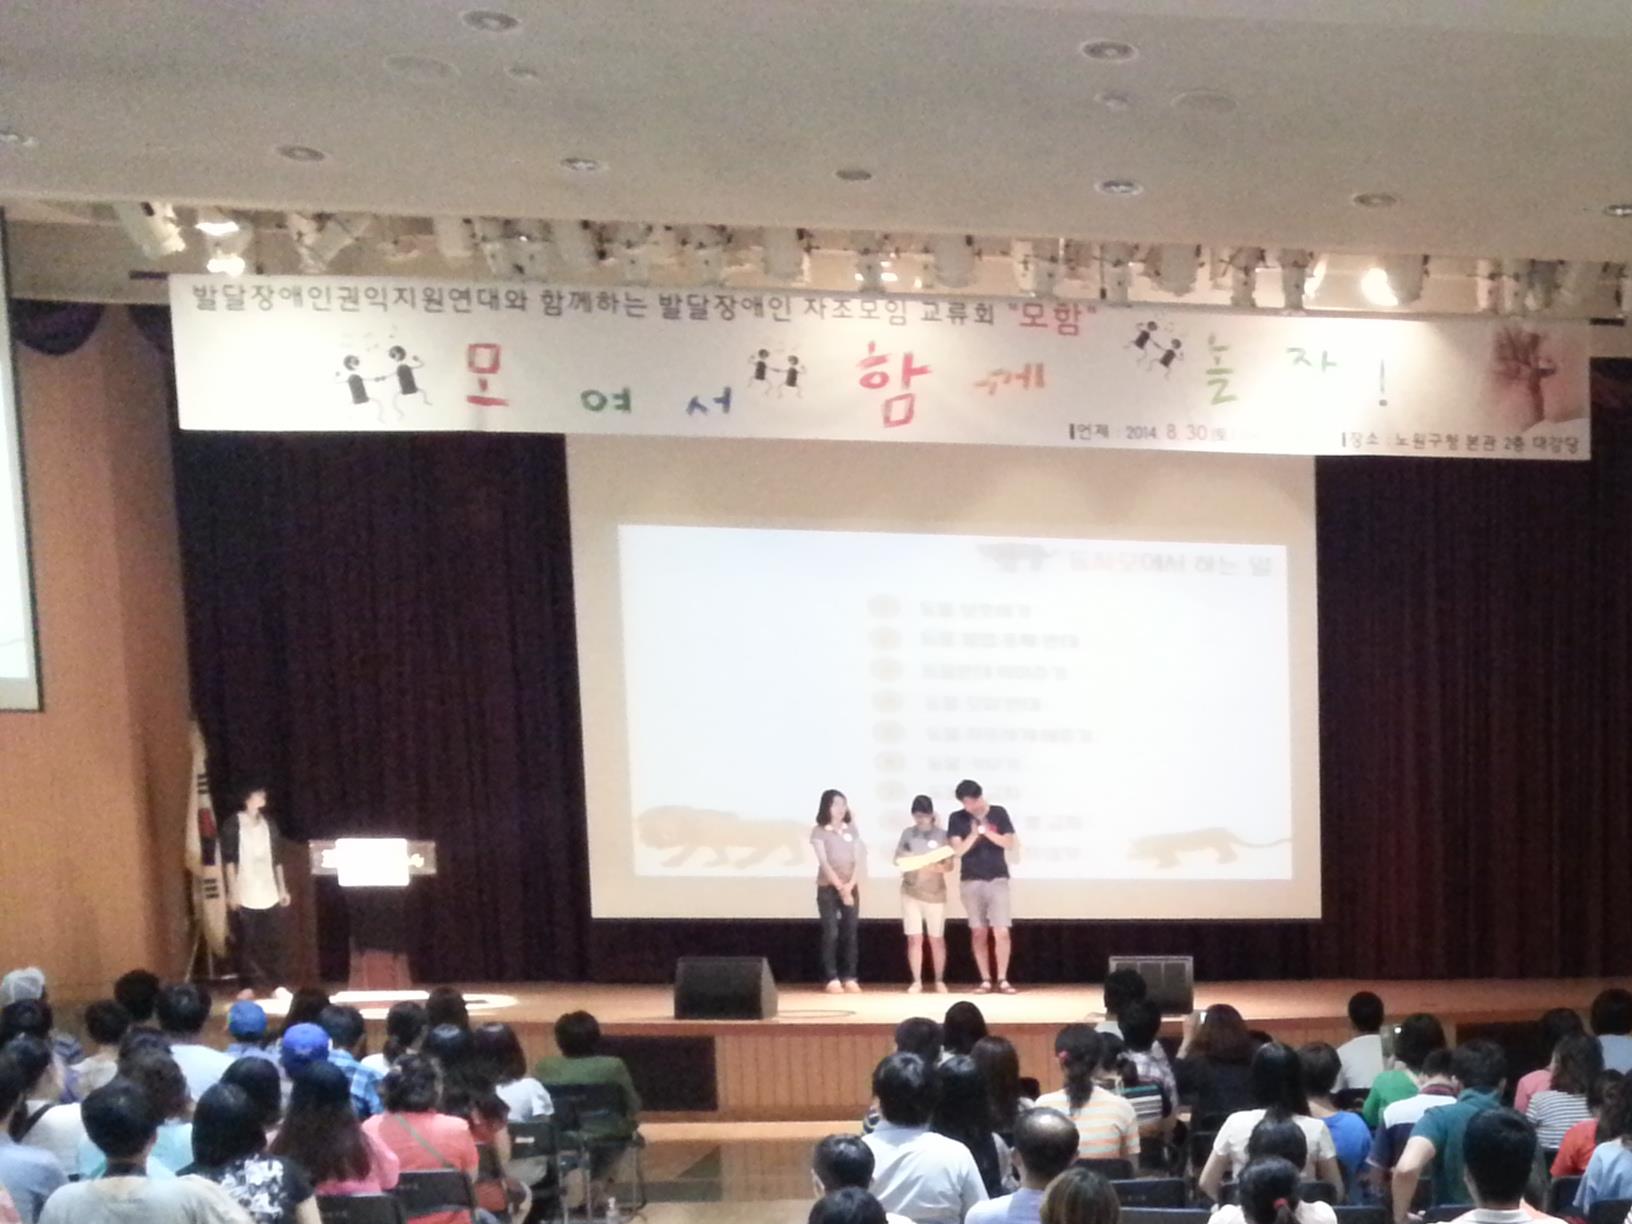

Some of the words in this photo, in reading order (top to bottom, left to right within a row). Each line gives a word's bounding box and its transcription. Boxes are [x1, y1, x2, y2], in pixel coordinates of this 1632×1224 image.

[192, 284, 529, 314] 발달장애인권익지원연대와
[540, 288, 648, 318] 함께하는
[658, 291, 792, 322] 발달장애인
[920, 300, 995, 326] 교류회
